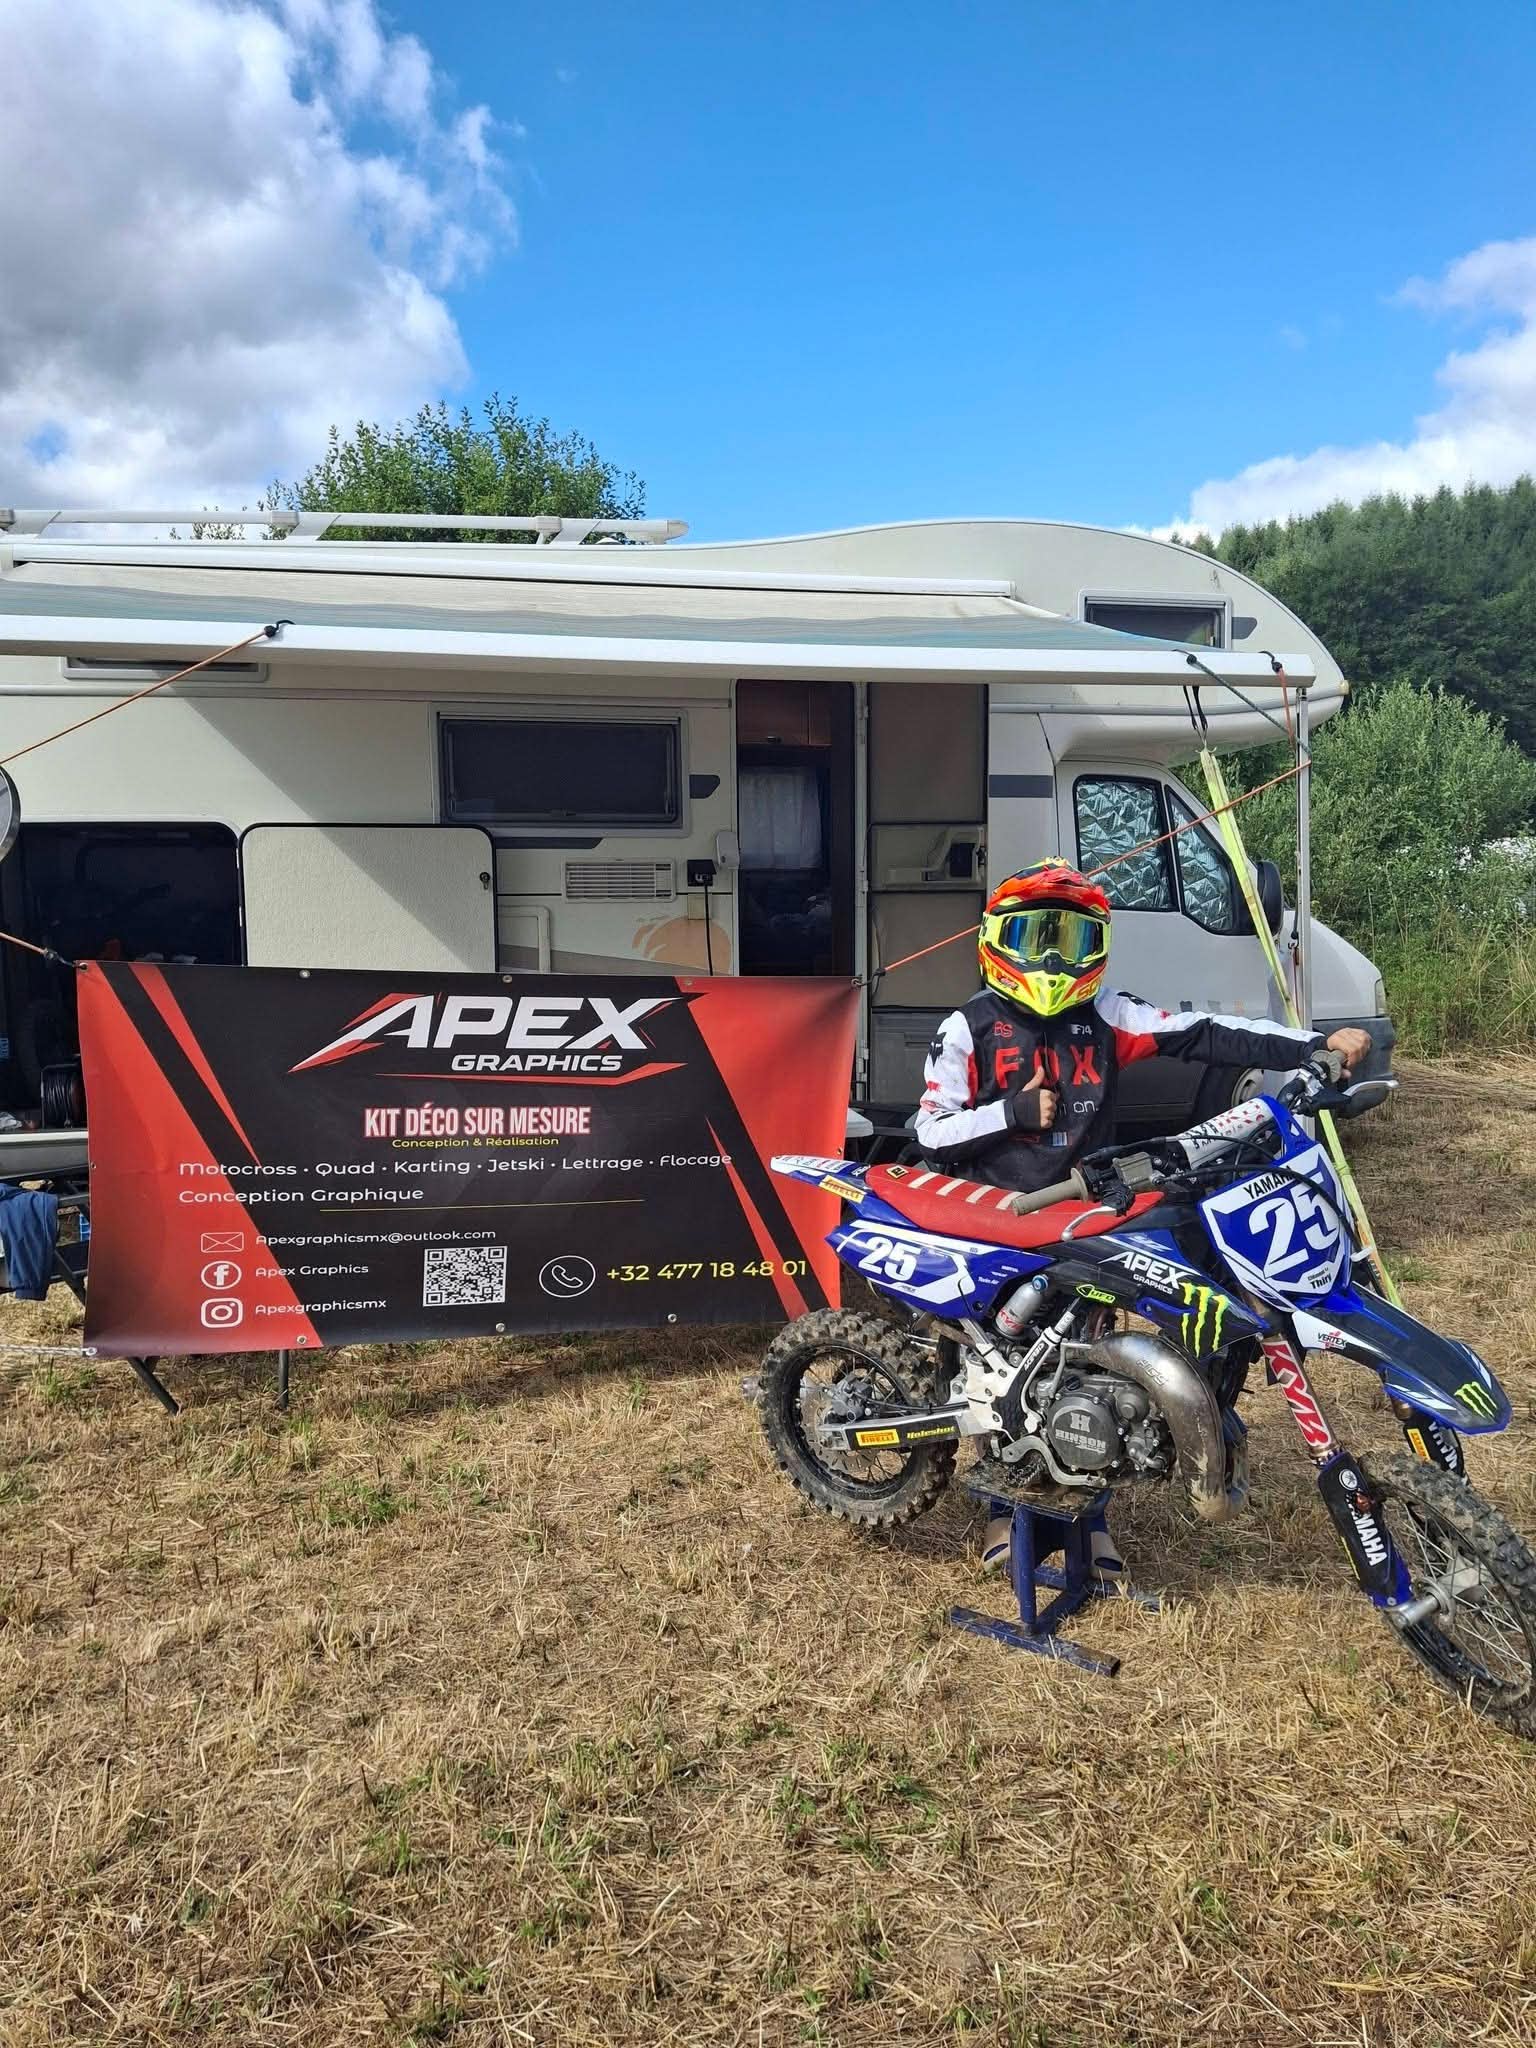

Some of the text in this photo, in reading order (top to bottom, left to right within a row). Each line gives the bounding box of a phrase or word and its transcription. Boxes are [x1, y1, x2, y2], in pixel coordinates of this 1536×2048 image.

[288, 994, 684, 1074] APEX
[451, 1054, 623, 1072] GRAPHICS
[994, 1045, 1102, 1089] FOX
[364, 1102, 592, 1138] KIT DÉCO SUR MESURE
[391, 1136, 560, 1149] Conception & Réalisation
[179, 1154, 732, 1176] Motocross Quad Karting Jetski Lettrage Flocage
[178, 1188, 425, 1204] Conception Graphique
[1249, 1171, 1341, 1279] 25
[255, 1231, 496, 1246] Apexgraphicsmx@outlook.com
[858, 1236, 922, 1282] 25
[255, 1264, 369, 1279] Apex Graphics
[606, 1260, 807, 1282] +32 477 18 48 01
[1098, 1251, 1195, 1290] APEX
[1132, 1273, 1174, 1295] GRAPHICS
[255, 1299, 387, 1314] Apexgraphicsmx
[1317, 1332, 1347, 1347] VERTEX
